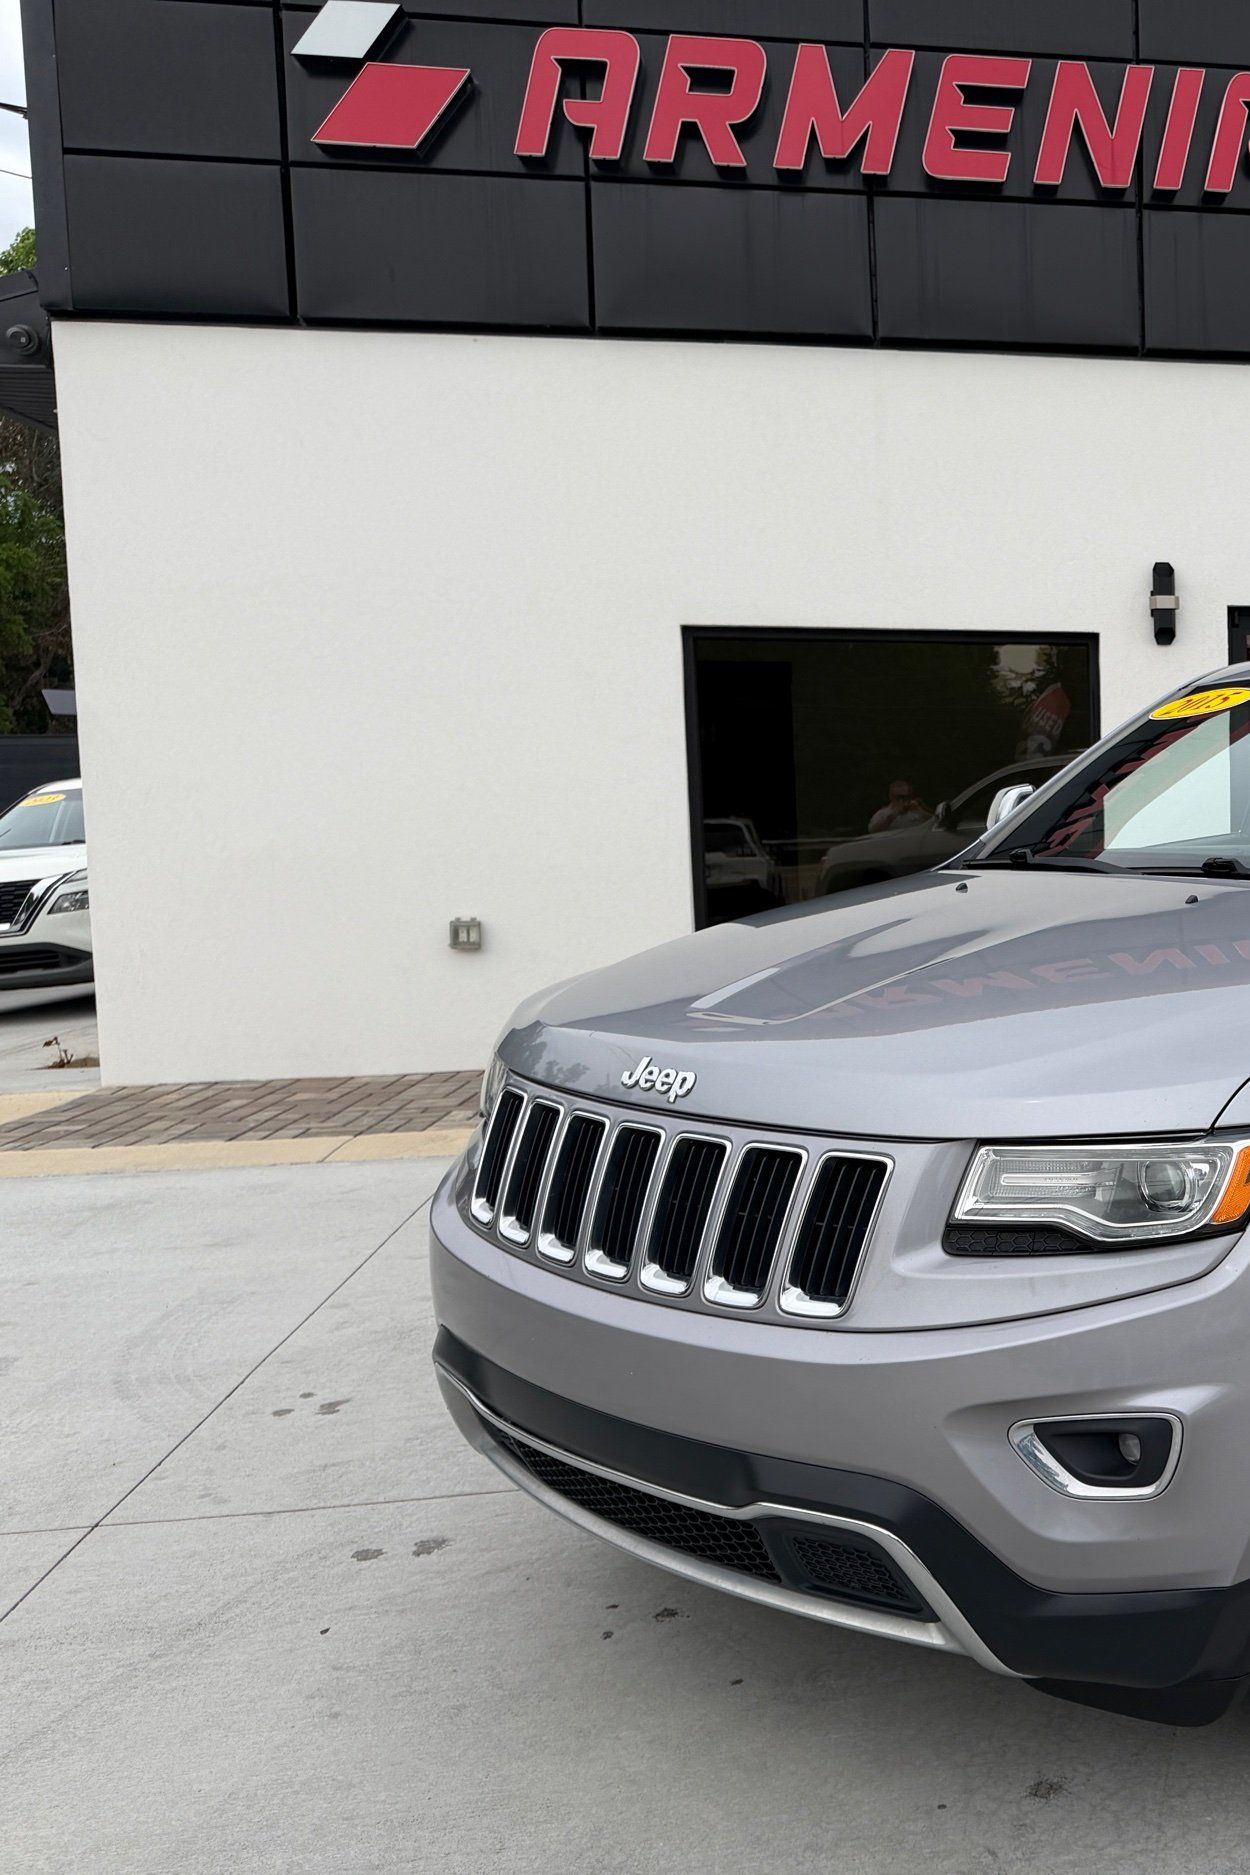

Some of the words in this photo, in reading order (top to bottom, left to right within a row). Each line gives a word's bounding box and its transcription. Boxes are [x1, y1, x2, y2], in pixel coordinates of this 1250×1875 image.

[1158, 691, 1242, 717] 2015
[1032, 706, 1063, 735] USED
[621, 1056, 697, 1104] Jeep
